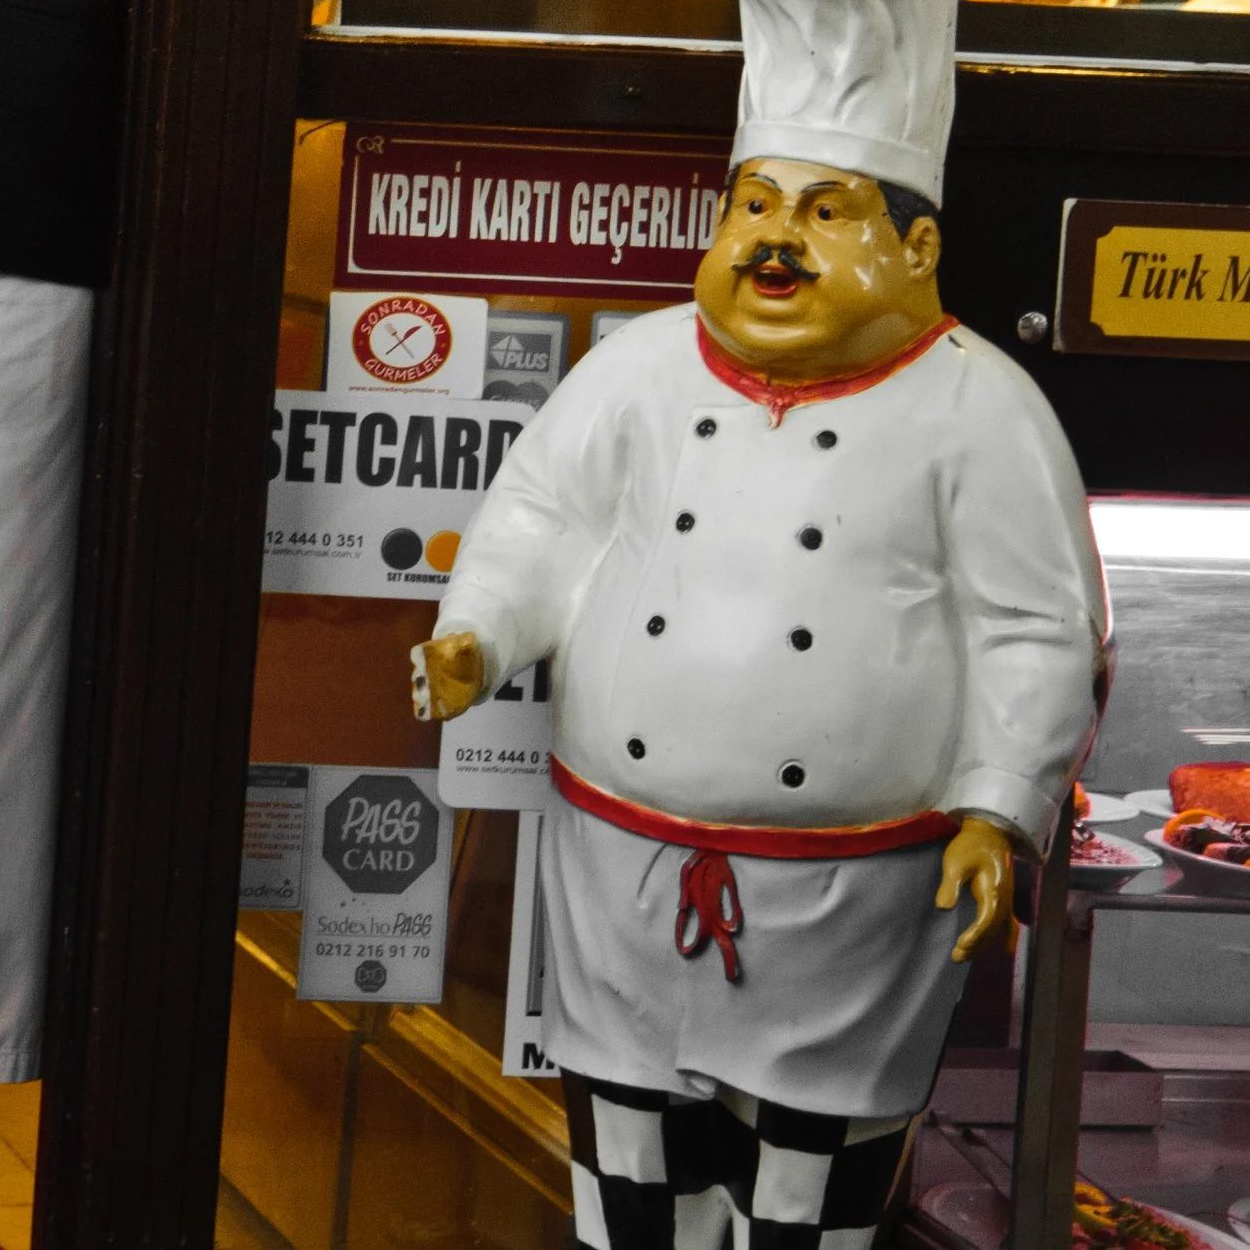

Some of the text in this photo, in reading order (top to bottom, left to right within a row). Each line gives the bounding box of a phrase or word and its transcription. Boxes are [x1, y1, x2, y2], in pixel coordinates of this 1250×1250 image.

[368, 160, 463, 239] KREDİ
[469, 177, 561, 244] KARTI
[1118, 252, 1210, 300] Türk
[361, 299, 446, 336] SONRADAN
[364, 352, 443, 382] GURMELER
[503, 350, 548, 370] PLUS
[289, 532, 317, 547] 444
[321, 533, 331, 547] 0
[337, 534, 364, 548] 351
[456, 749, 493, 762] 0212
[497, 750, 525, 764] 444
[340, 796, 422, 845] PASS
[342, 849, 416, 872] CARD
[239, 881, 294, 899] odexo
[316, 943, 430, 958] 0212 216 91 70
